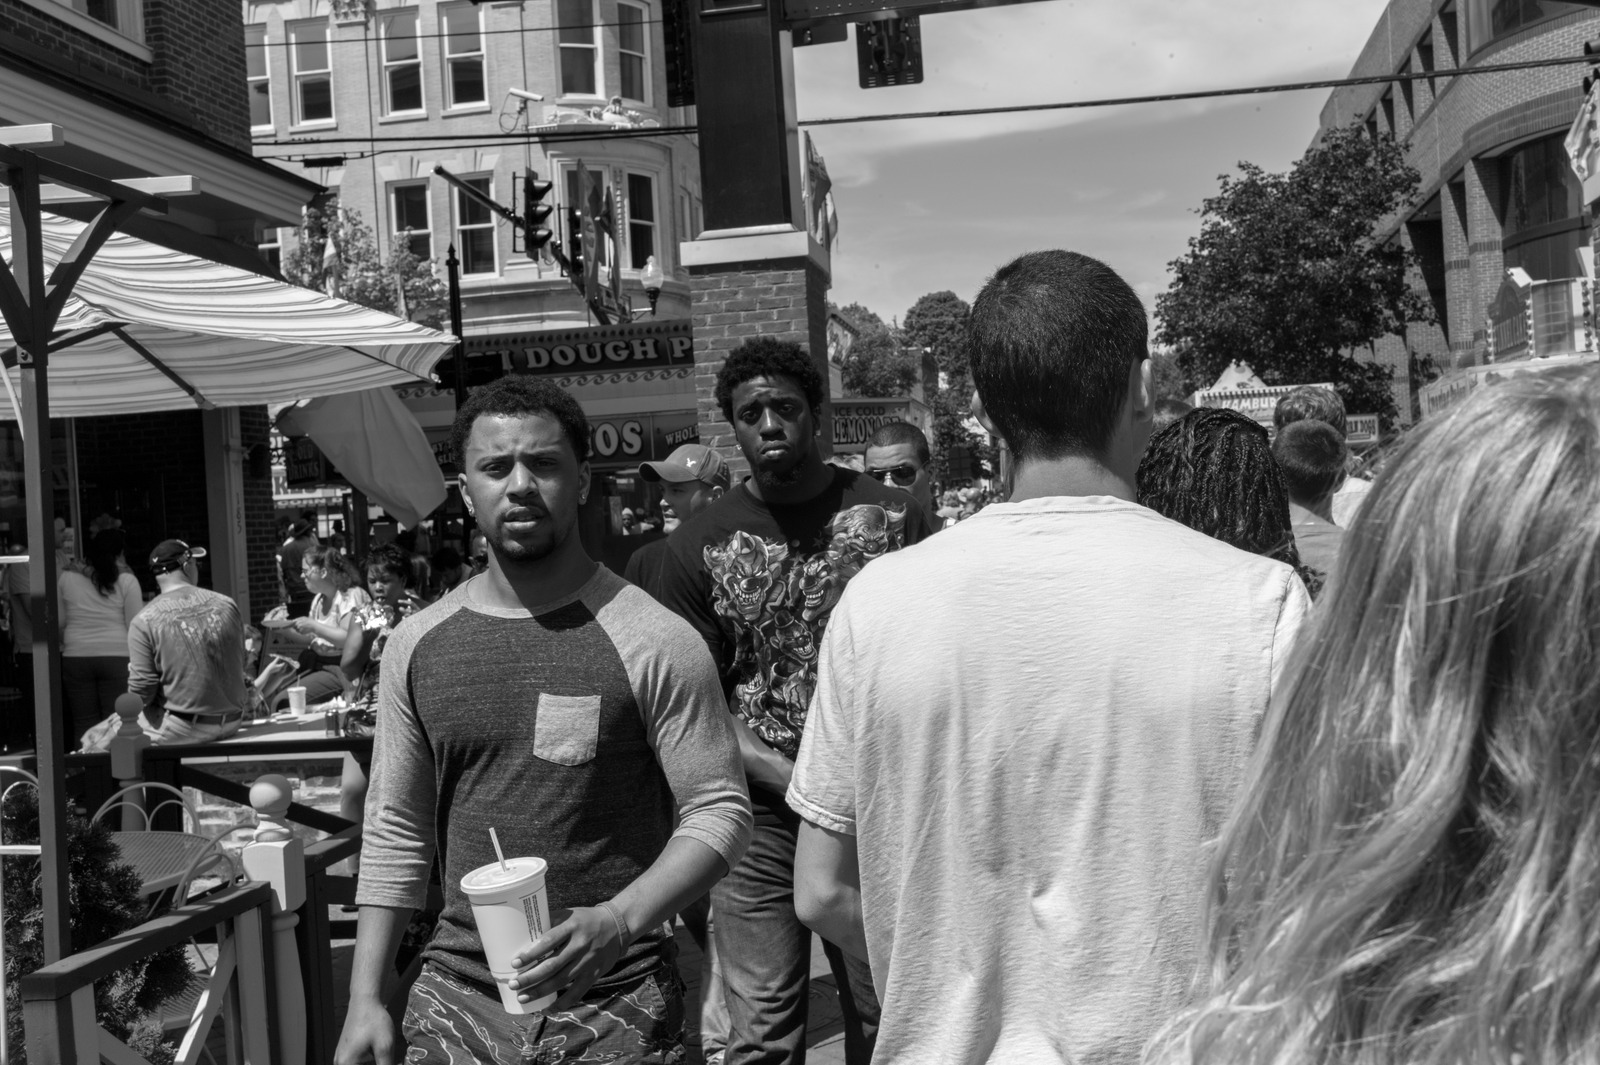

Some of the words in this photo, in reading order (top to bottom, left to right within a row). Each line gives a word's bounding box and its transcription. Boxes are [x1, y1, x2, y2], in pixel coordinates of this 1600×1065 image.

[524, 338, 659, 369] DOUGH
[668, 336, 692, 358] P
[834, 406, 853, 417] ICE
[855, 406, 886, 416] COLD
[1221, 397, 1280, 411] HAMBUR
[587, 420, 643, 457] OS
[832, 416, 901, 444] LEMON
[277, 498, 325, 506] CORN
